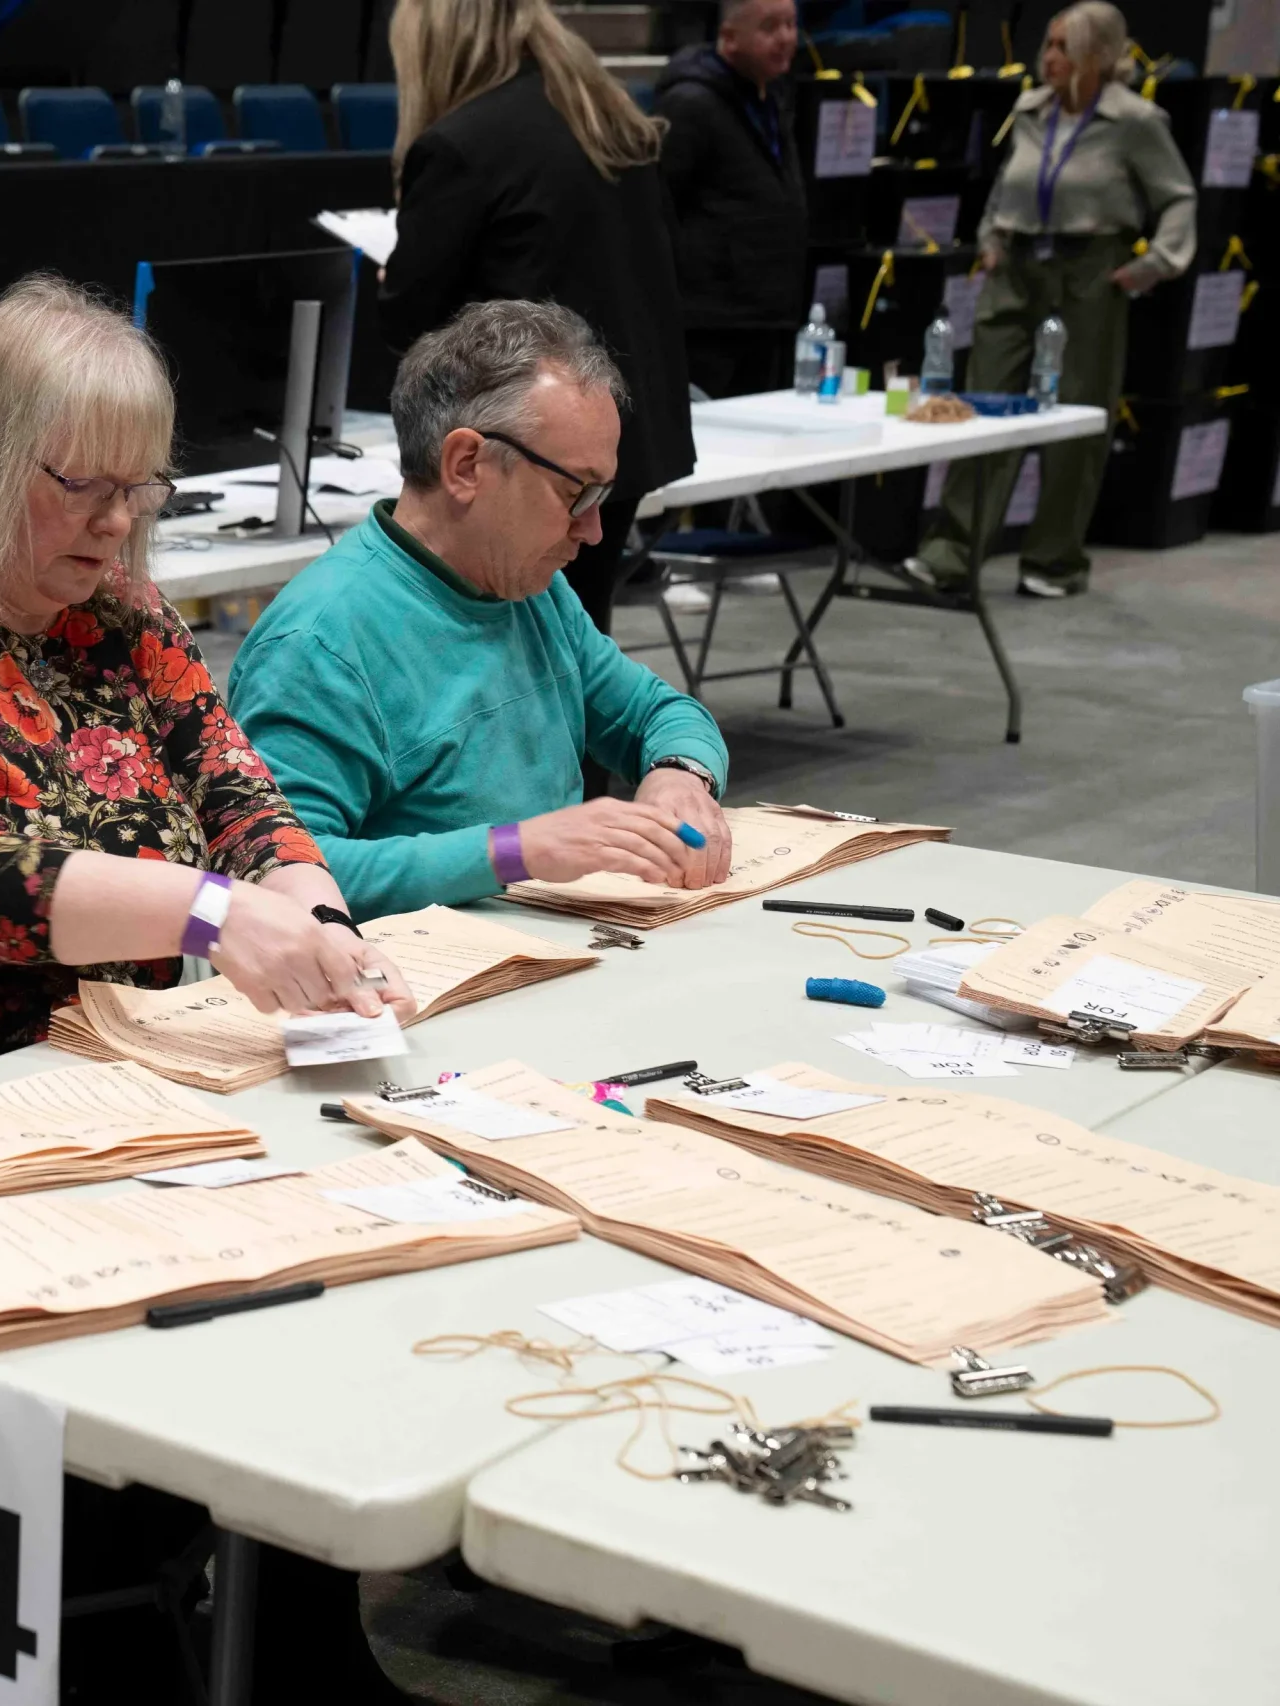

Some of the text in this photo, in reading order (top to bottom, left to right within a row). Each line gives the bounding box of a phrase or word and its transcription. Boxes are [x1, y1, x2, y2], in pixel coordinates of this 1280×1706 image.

[1084, 1001, 1128, 1017] FOR
[1023, 1043, 1042, 1057] FOR
[1049, 1047, 1068, 1058] 50
[930, 1061, 975, 1069] FOR
